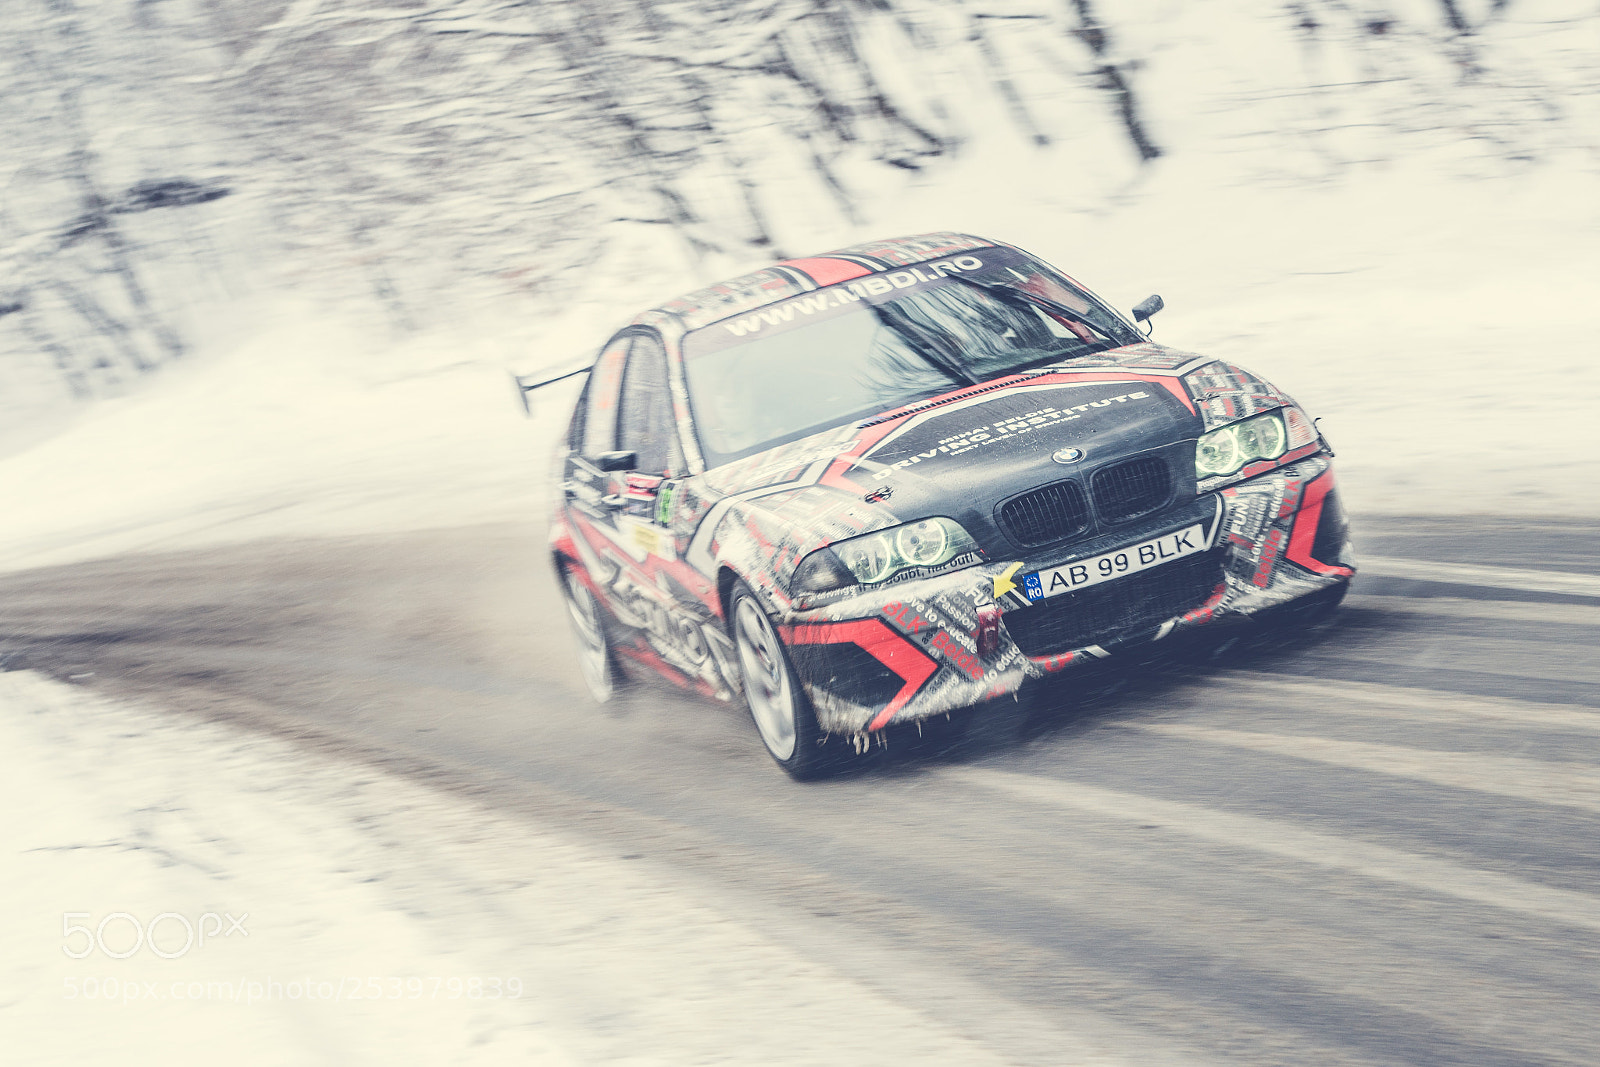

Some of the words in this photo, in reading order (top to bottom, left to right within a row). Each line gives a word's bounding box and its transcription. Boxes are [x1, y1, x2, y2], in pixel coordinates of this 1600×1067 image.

[723, 256, 983, 336] WWW.MBDI.RO
[872, 433, 992, 480] DRIVING
[997, 391, 1150, 434] INSTITUTE
[938, 426, 989, 445] MIHAI
[1049, 565, 1089, 592] AB
[1098, 553, 1129, 577] 99
[1138, 531, 1195, 566] BLK
[1028, 587, 1042, 600] RO
[881, 599, 929, 636] BLK
[924, 608, 938, 623] to
[935, 595, 977, 631] Passion
[931, 630, 985, 681] Beldie
